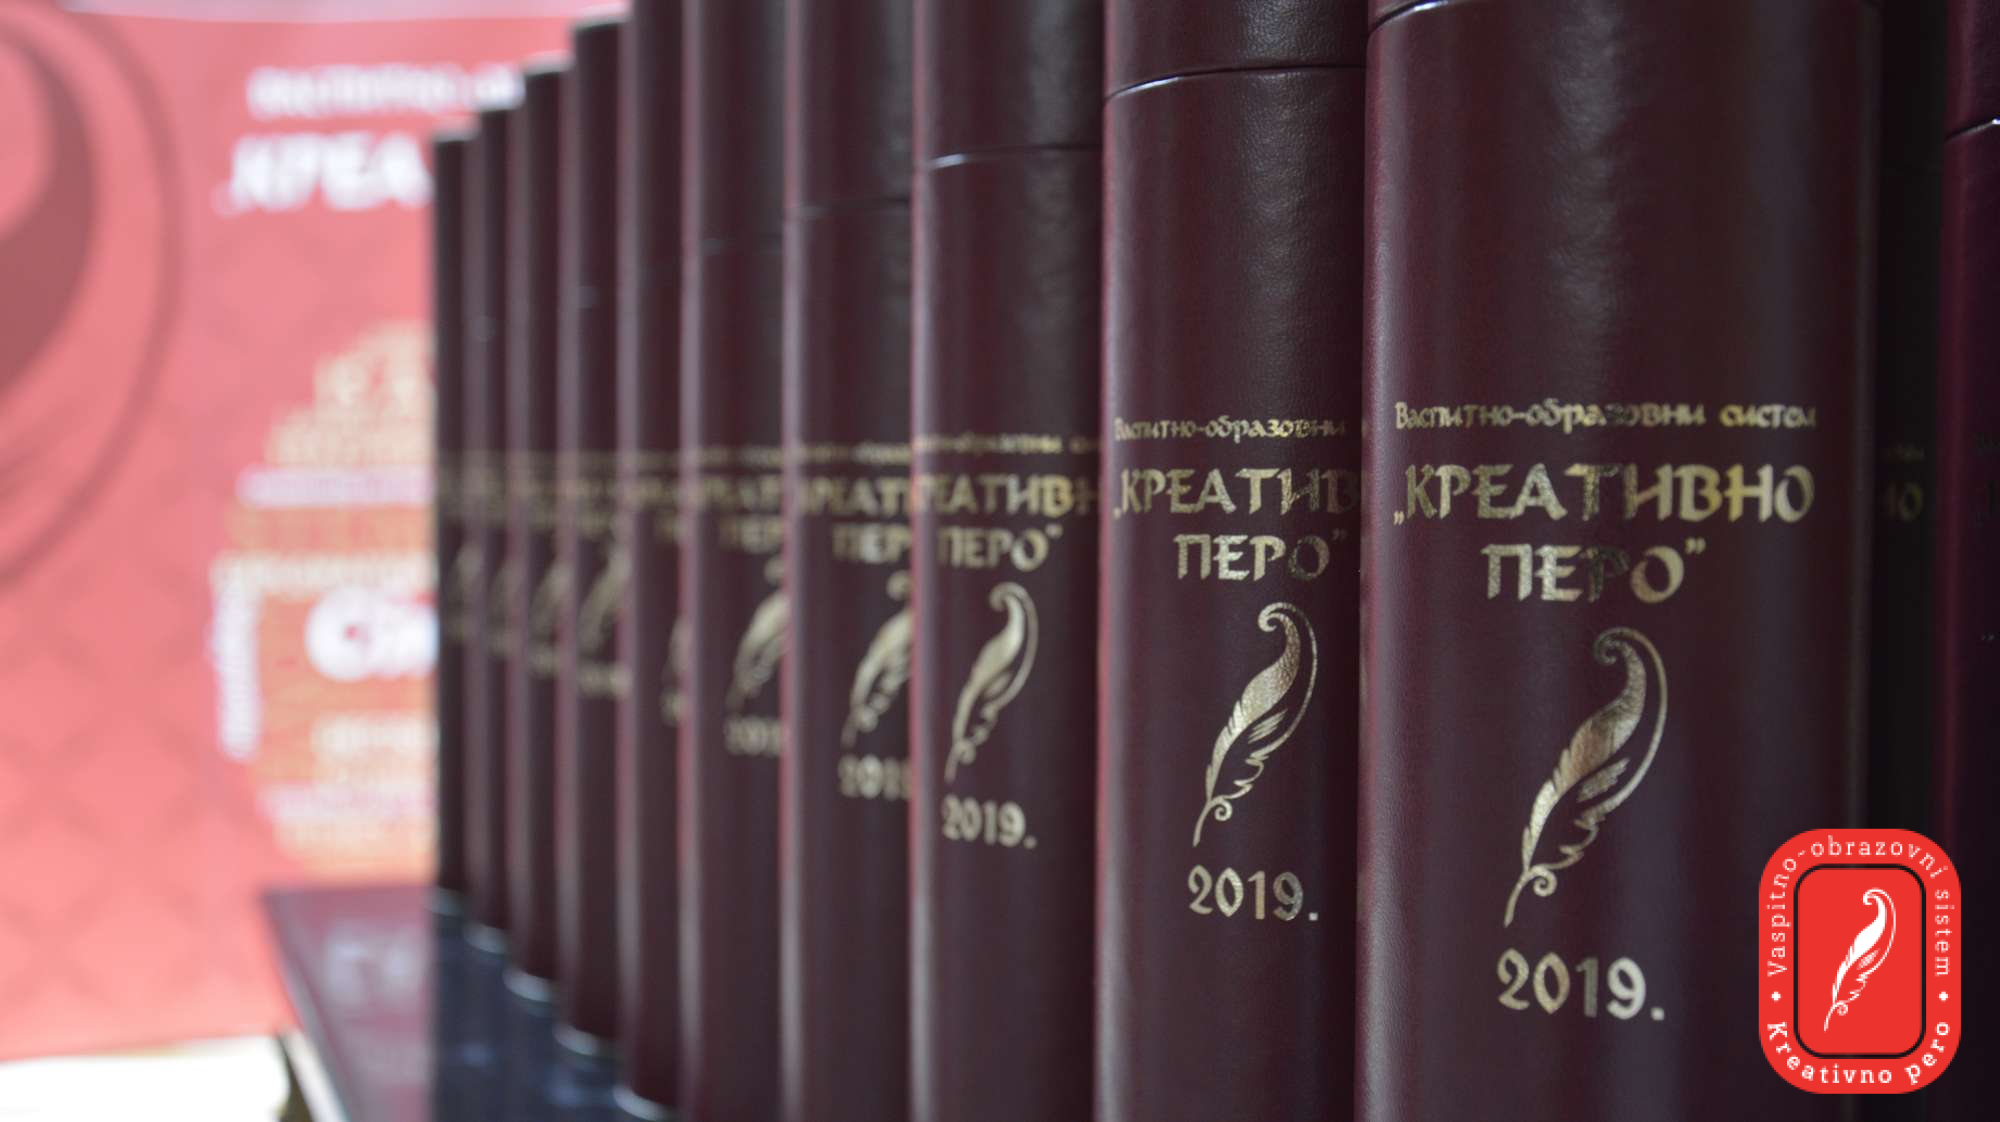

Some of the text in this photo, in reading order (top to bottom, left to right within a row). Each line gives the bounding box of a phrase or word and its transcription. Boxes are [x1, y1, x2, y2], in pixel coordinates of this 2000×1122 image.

[1394, 399, 1706, 435] Васпитно-образовни
[942, 794, 1037, 850] 2019.
[1188, 864, 1319, 922] 2019.
[1497, 947, 1665, 1021] 2019.
